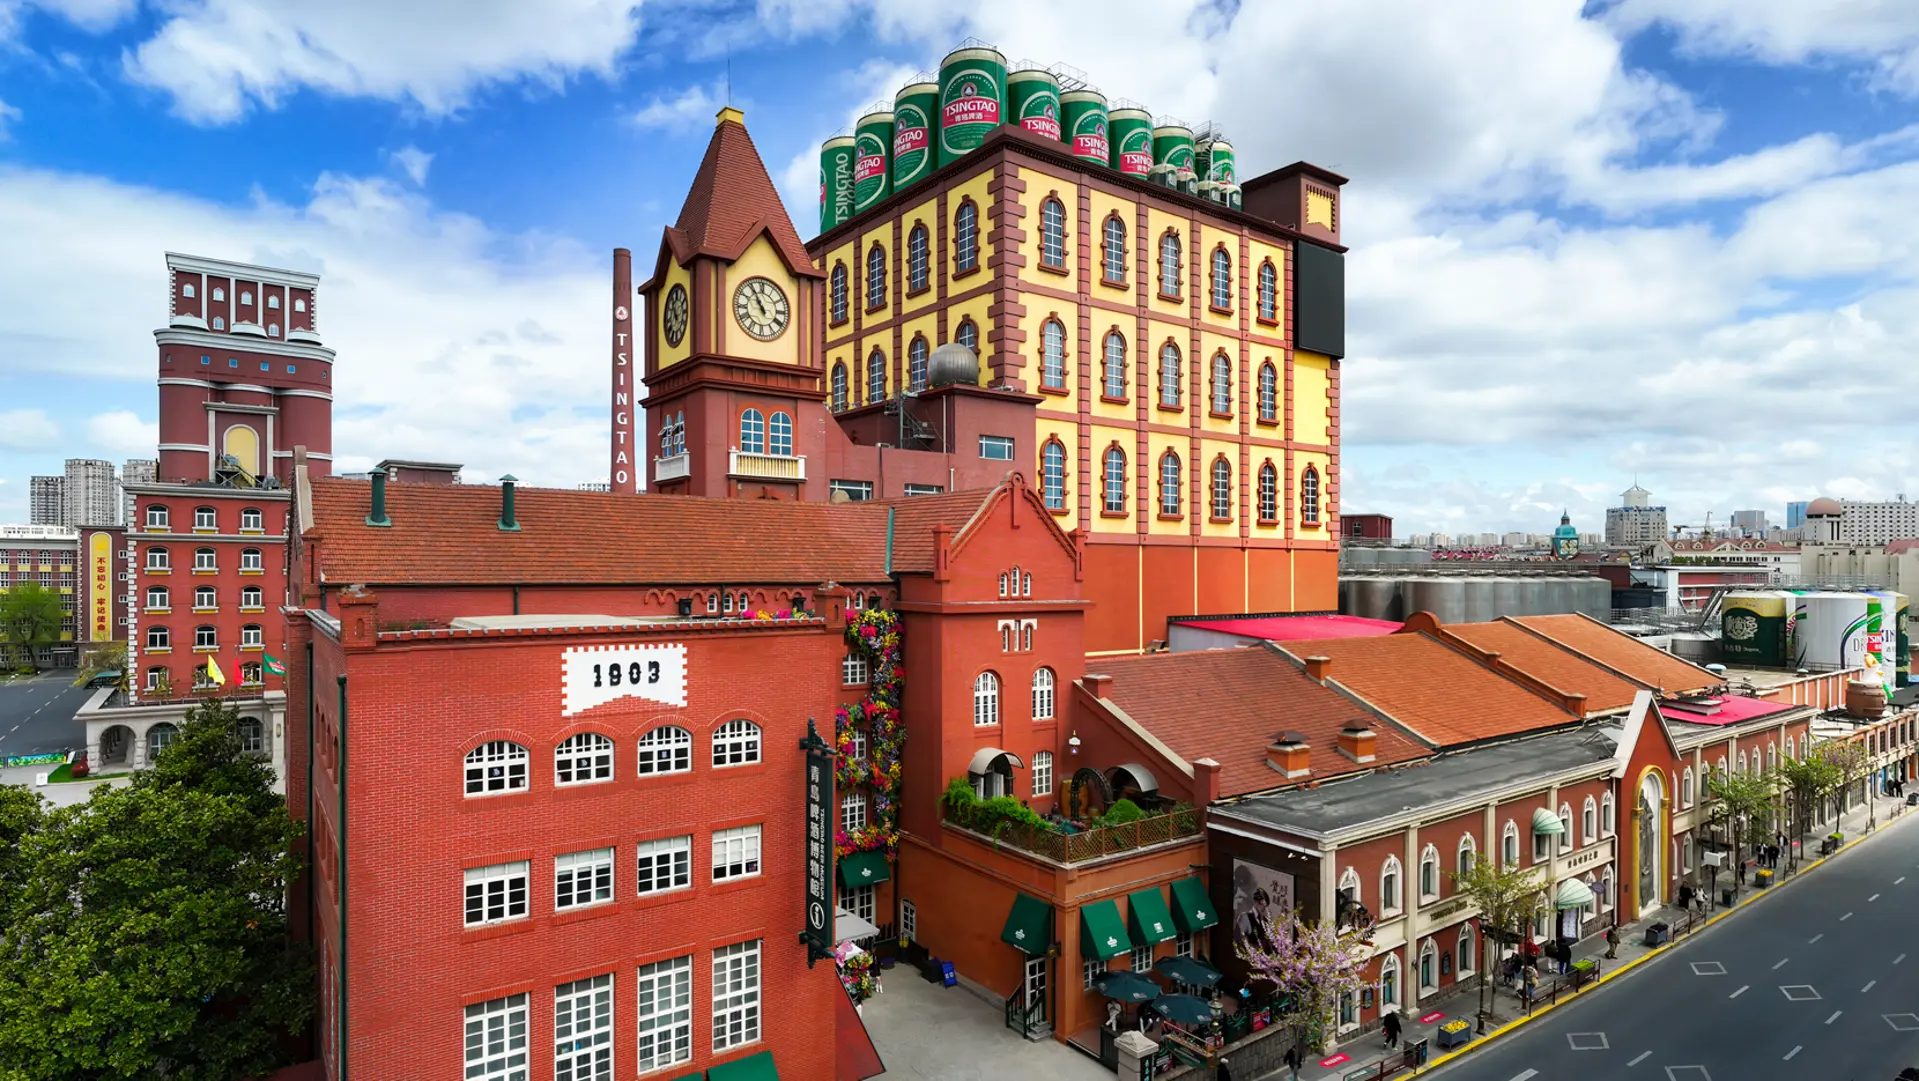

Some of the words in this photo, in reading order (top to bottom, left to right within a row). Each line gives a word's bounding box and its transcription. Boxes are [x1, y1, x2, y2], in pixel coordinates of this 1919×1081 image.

[945, 100, 997, 117] TSINGTAO
[836, 152, 849, 225] TSINGTAO
[616, 333, 629, 484] TSINGTAO
[593, 660, 660, 687] 1903
